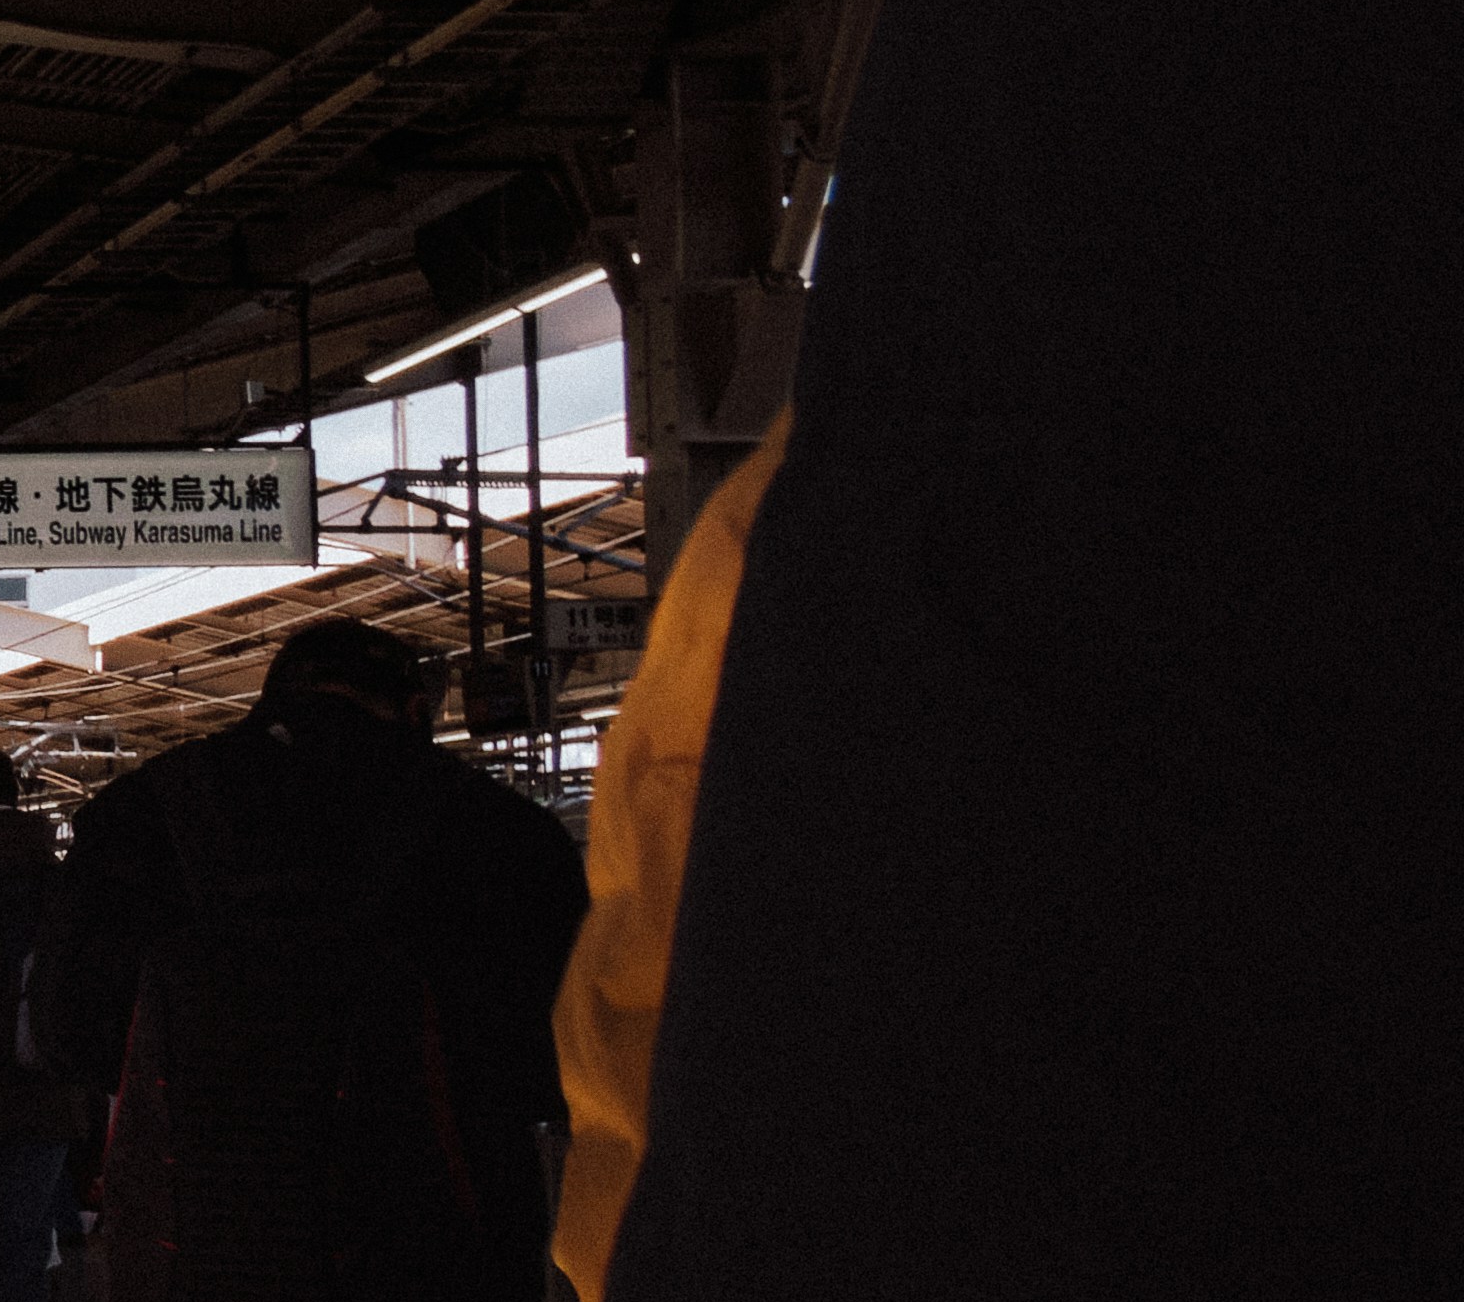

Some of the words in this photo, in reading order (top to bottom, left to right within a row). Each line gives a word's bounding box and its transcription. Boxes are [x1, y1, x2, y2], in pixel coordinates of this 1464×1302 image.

[49, 520, 127, 550] Subway
[133, 519, 234, 545] Karasuma
[240, 519, 283, 544] Line
